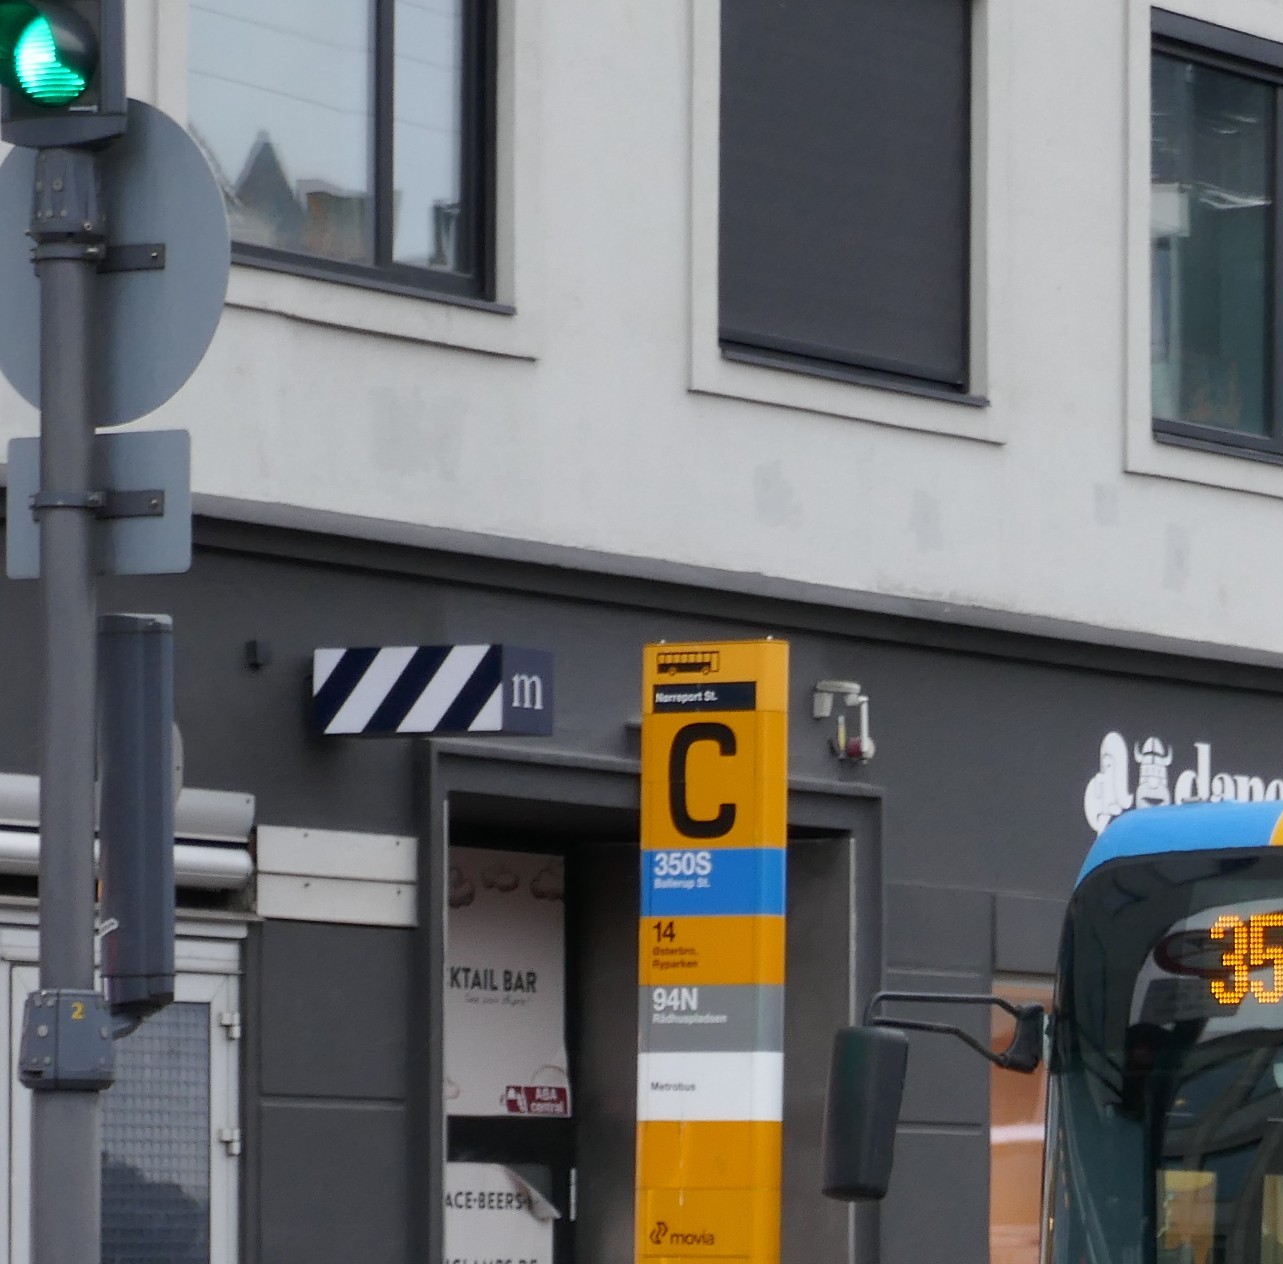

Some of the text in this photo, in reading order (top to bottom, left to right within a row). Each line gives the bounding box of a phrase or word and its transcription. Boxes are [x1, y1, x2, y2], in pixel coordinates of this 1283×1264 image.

[512, 673, 544, 710] m
[668, 722, 737, 840] C
[653, 851, 712, 876] 350S
[653, 920, 676, 943] 14
[449, 966, 538, 994] KTAIL BAR
[71, 1001, 85, 1020] 2
[653, 987, 699, 1011] 94N
[670, 1228, 714, 1246] movia
